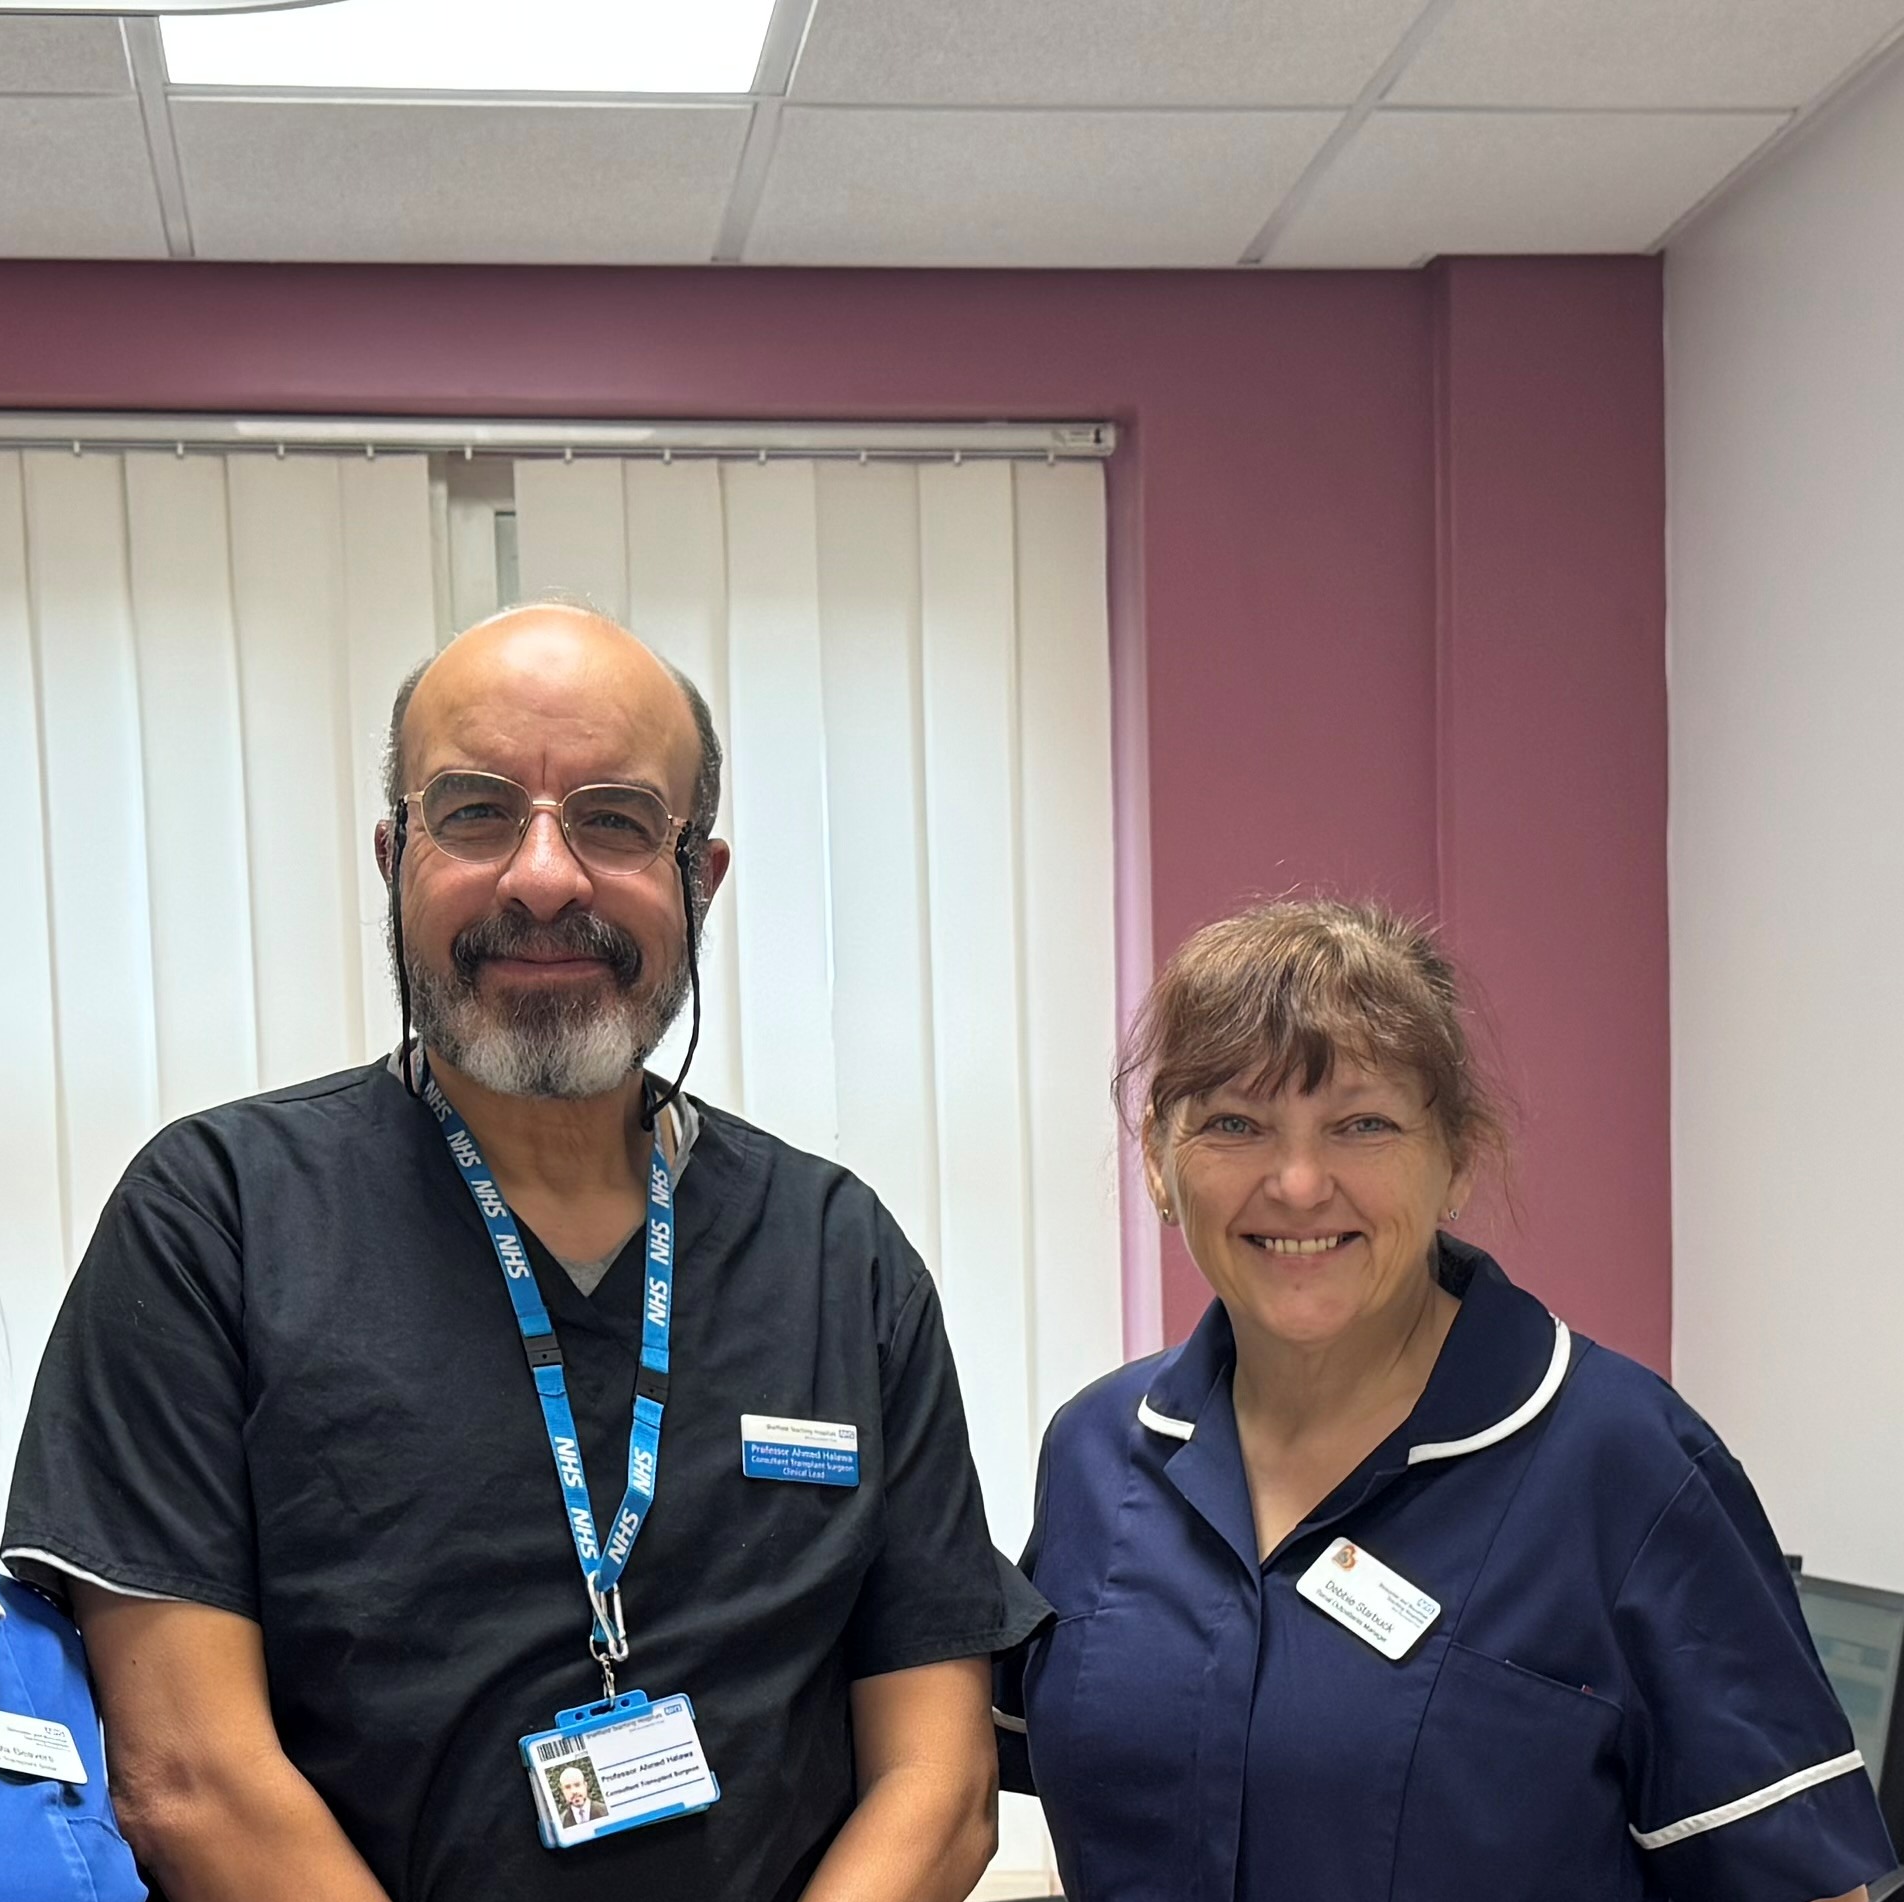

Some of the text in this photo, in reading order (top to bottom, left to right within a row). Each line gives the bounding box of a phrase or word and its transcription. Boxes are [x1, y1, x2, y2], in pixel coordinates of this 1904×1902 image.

[424, 1079, 452, 1122] NHS
[447, 1130, 481, 1167] NHS
[471, 1180, 507, 1218] NHS
[651, 1164, 669, 1208] NHS
[495, 1234, 530, 1279] NHS
[651, 1219, 670, 1265] NHS
[647, 1277, 667, 1327] NHS
[555, 1436, 583, 1488] NHS
[633, 1447, 653, 1495] NHS
[751, 1444, 788, 1456] Professor
[791, 1448, 820, 1459] Ahmed
[751, 1455, 854, 1472] Consultant Transplant Surgeon
[783, 1467, 824, 1478] Clinical Lead
[571, 1507, 599, 1559] NHS
[608, 1508, 638, 1564] NHS
[1325, 1580, 1355, 1605] Debbie
[601, 1768, 636, 1782] Professor
[639, 1759, 665, 1771] Ahmed
